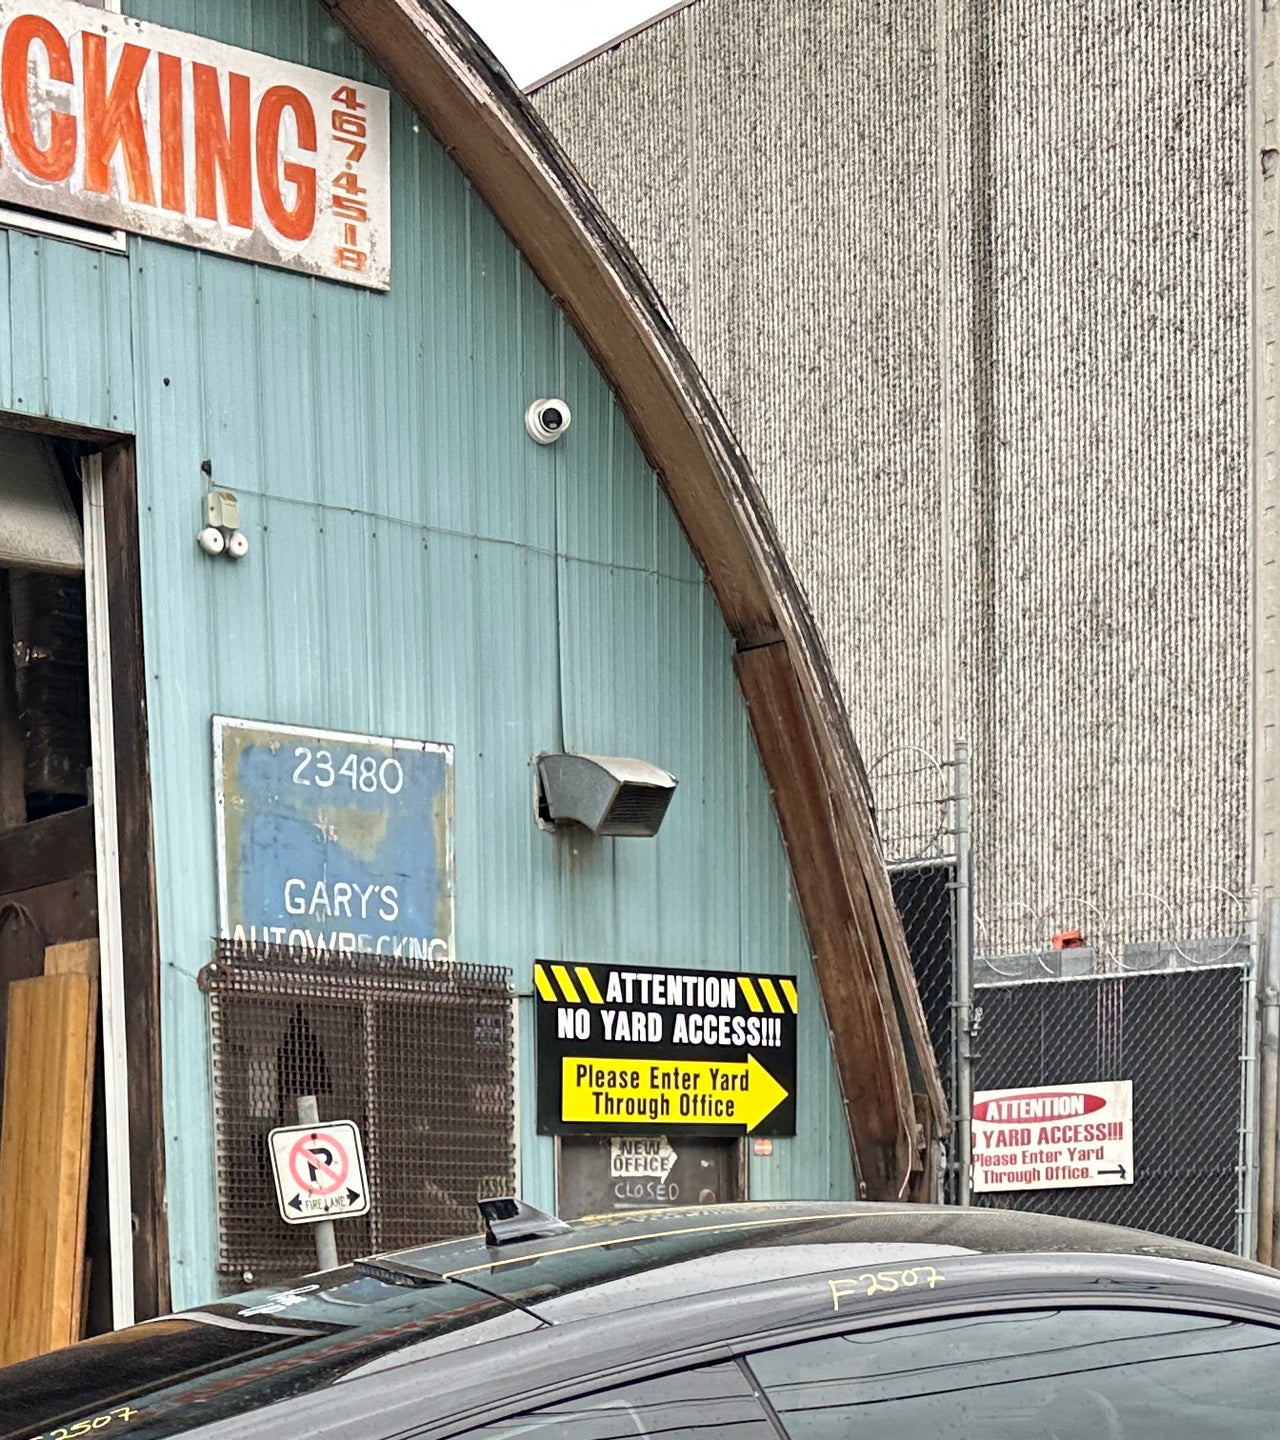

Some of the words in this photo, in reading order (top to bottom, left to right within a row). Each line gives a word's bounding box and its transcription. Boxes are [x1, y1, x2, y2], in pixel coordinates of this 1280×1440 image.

[292, 746, 404, 795] 23480
[284, 878, 399, 922] GARY'S
[605, 971, 736, 1009] ATTENTION
[557, 1007, 591, 1040] NO
[600, 1009, 663, 1043] YARD
[672, 1013, 782, 1047] ACCESS!!!
[576, 1064, 640, 1088] Please
[650, 1066, 700, 1090] Enter
[709, 1068, 749, 1092] Yard
[592, 1091, 670, 1120] Through
[679, 1093, 735, 1117] Office
[985, 1095, 1085, 1121] ATTENTION
[621, 1140, 660, 1156] NEW
[983, 1128, 1032, 1150] YARD
[1037, 1122, 1124, 1146] ACCESS!!!
[613, 1156, 670, 1173] OFFICE
[972, 1153, 1018, 1168] Please
[1022, 1149, 1063, 1165] Enter
[1067, 1146, 1105, 1163] Yard
[982, 1167, 1041, 1185] Through
[305, 1199, 322, 1210] FIRE
[614, 1180, 680, 1201] CLOSED
[828, 1266, 946, 1312] F2507
